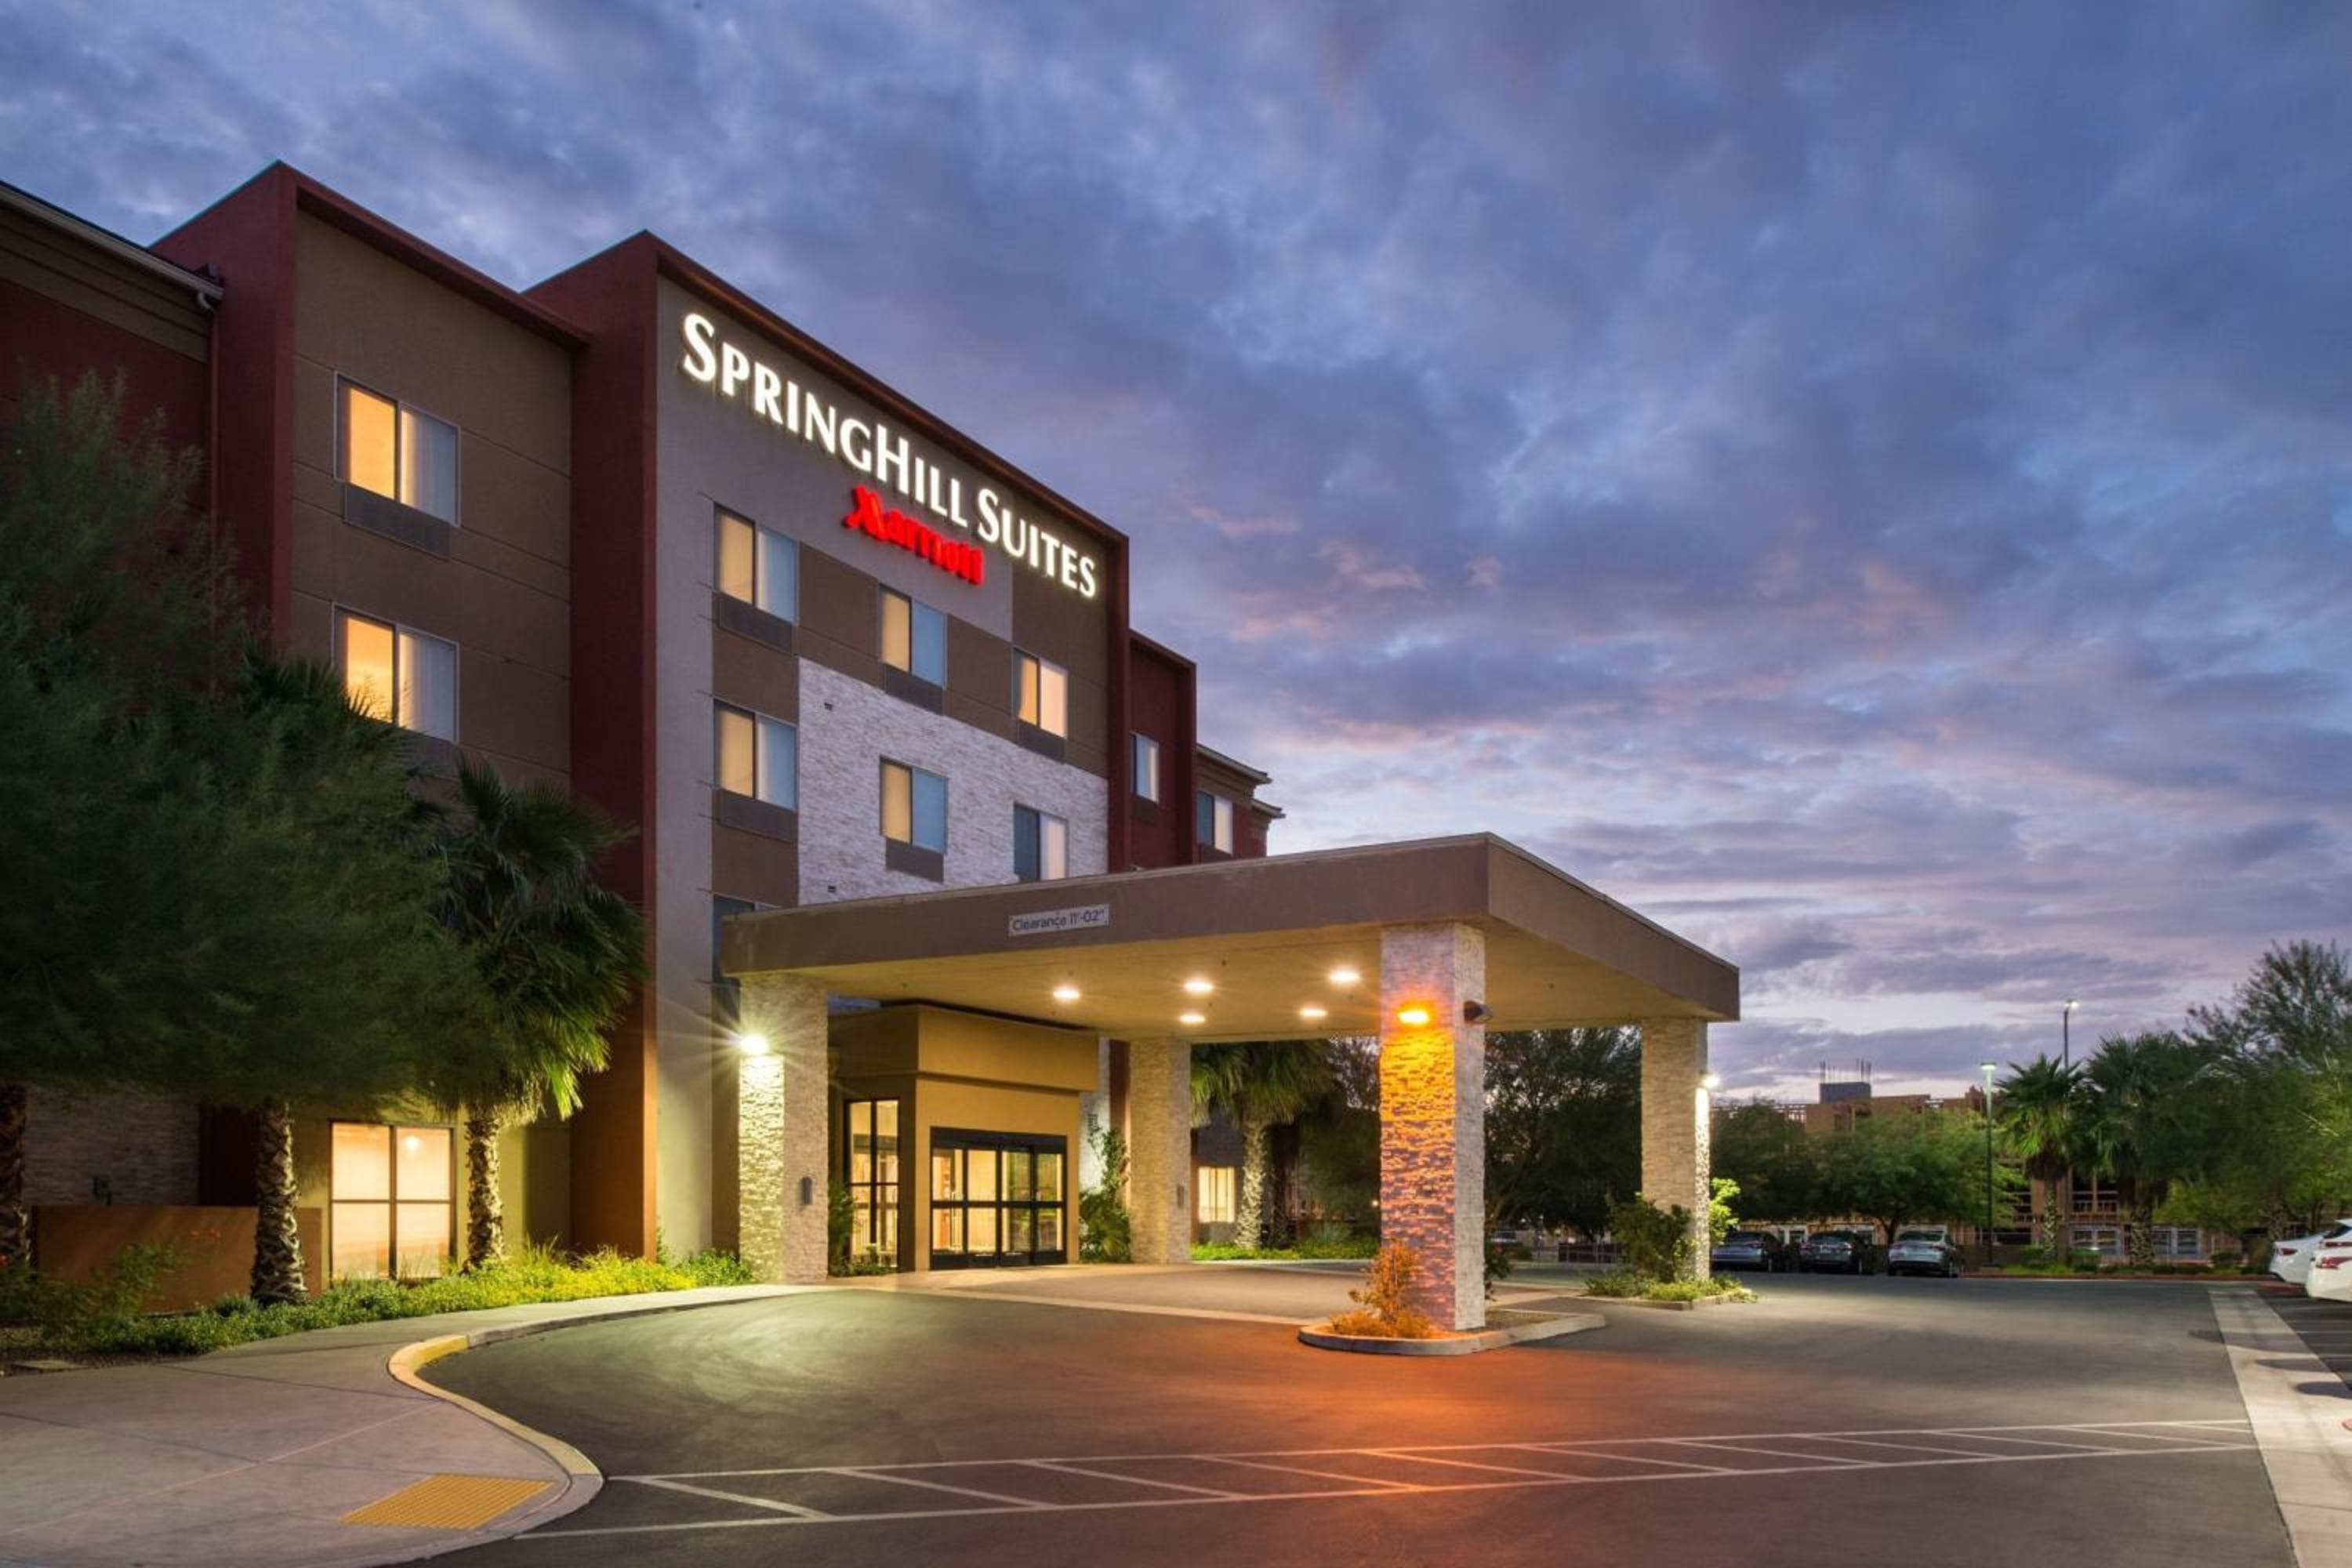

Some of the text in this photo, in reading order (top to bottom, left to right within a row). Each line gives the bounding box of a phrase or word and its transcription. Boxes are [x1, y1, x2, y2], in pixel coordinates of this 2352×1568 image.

[683, 314, 1097, 599] SPRINGHILL SUITES
[1013, 916, 1067, 931] Clearance
